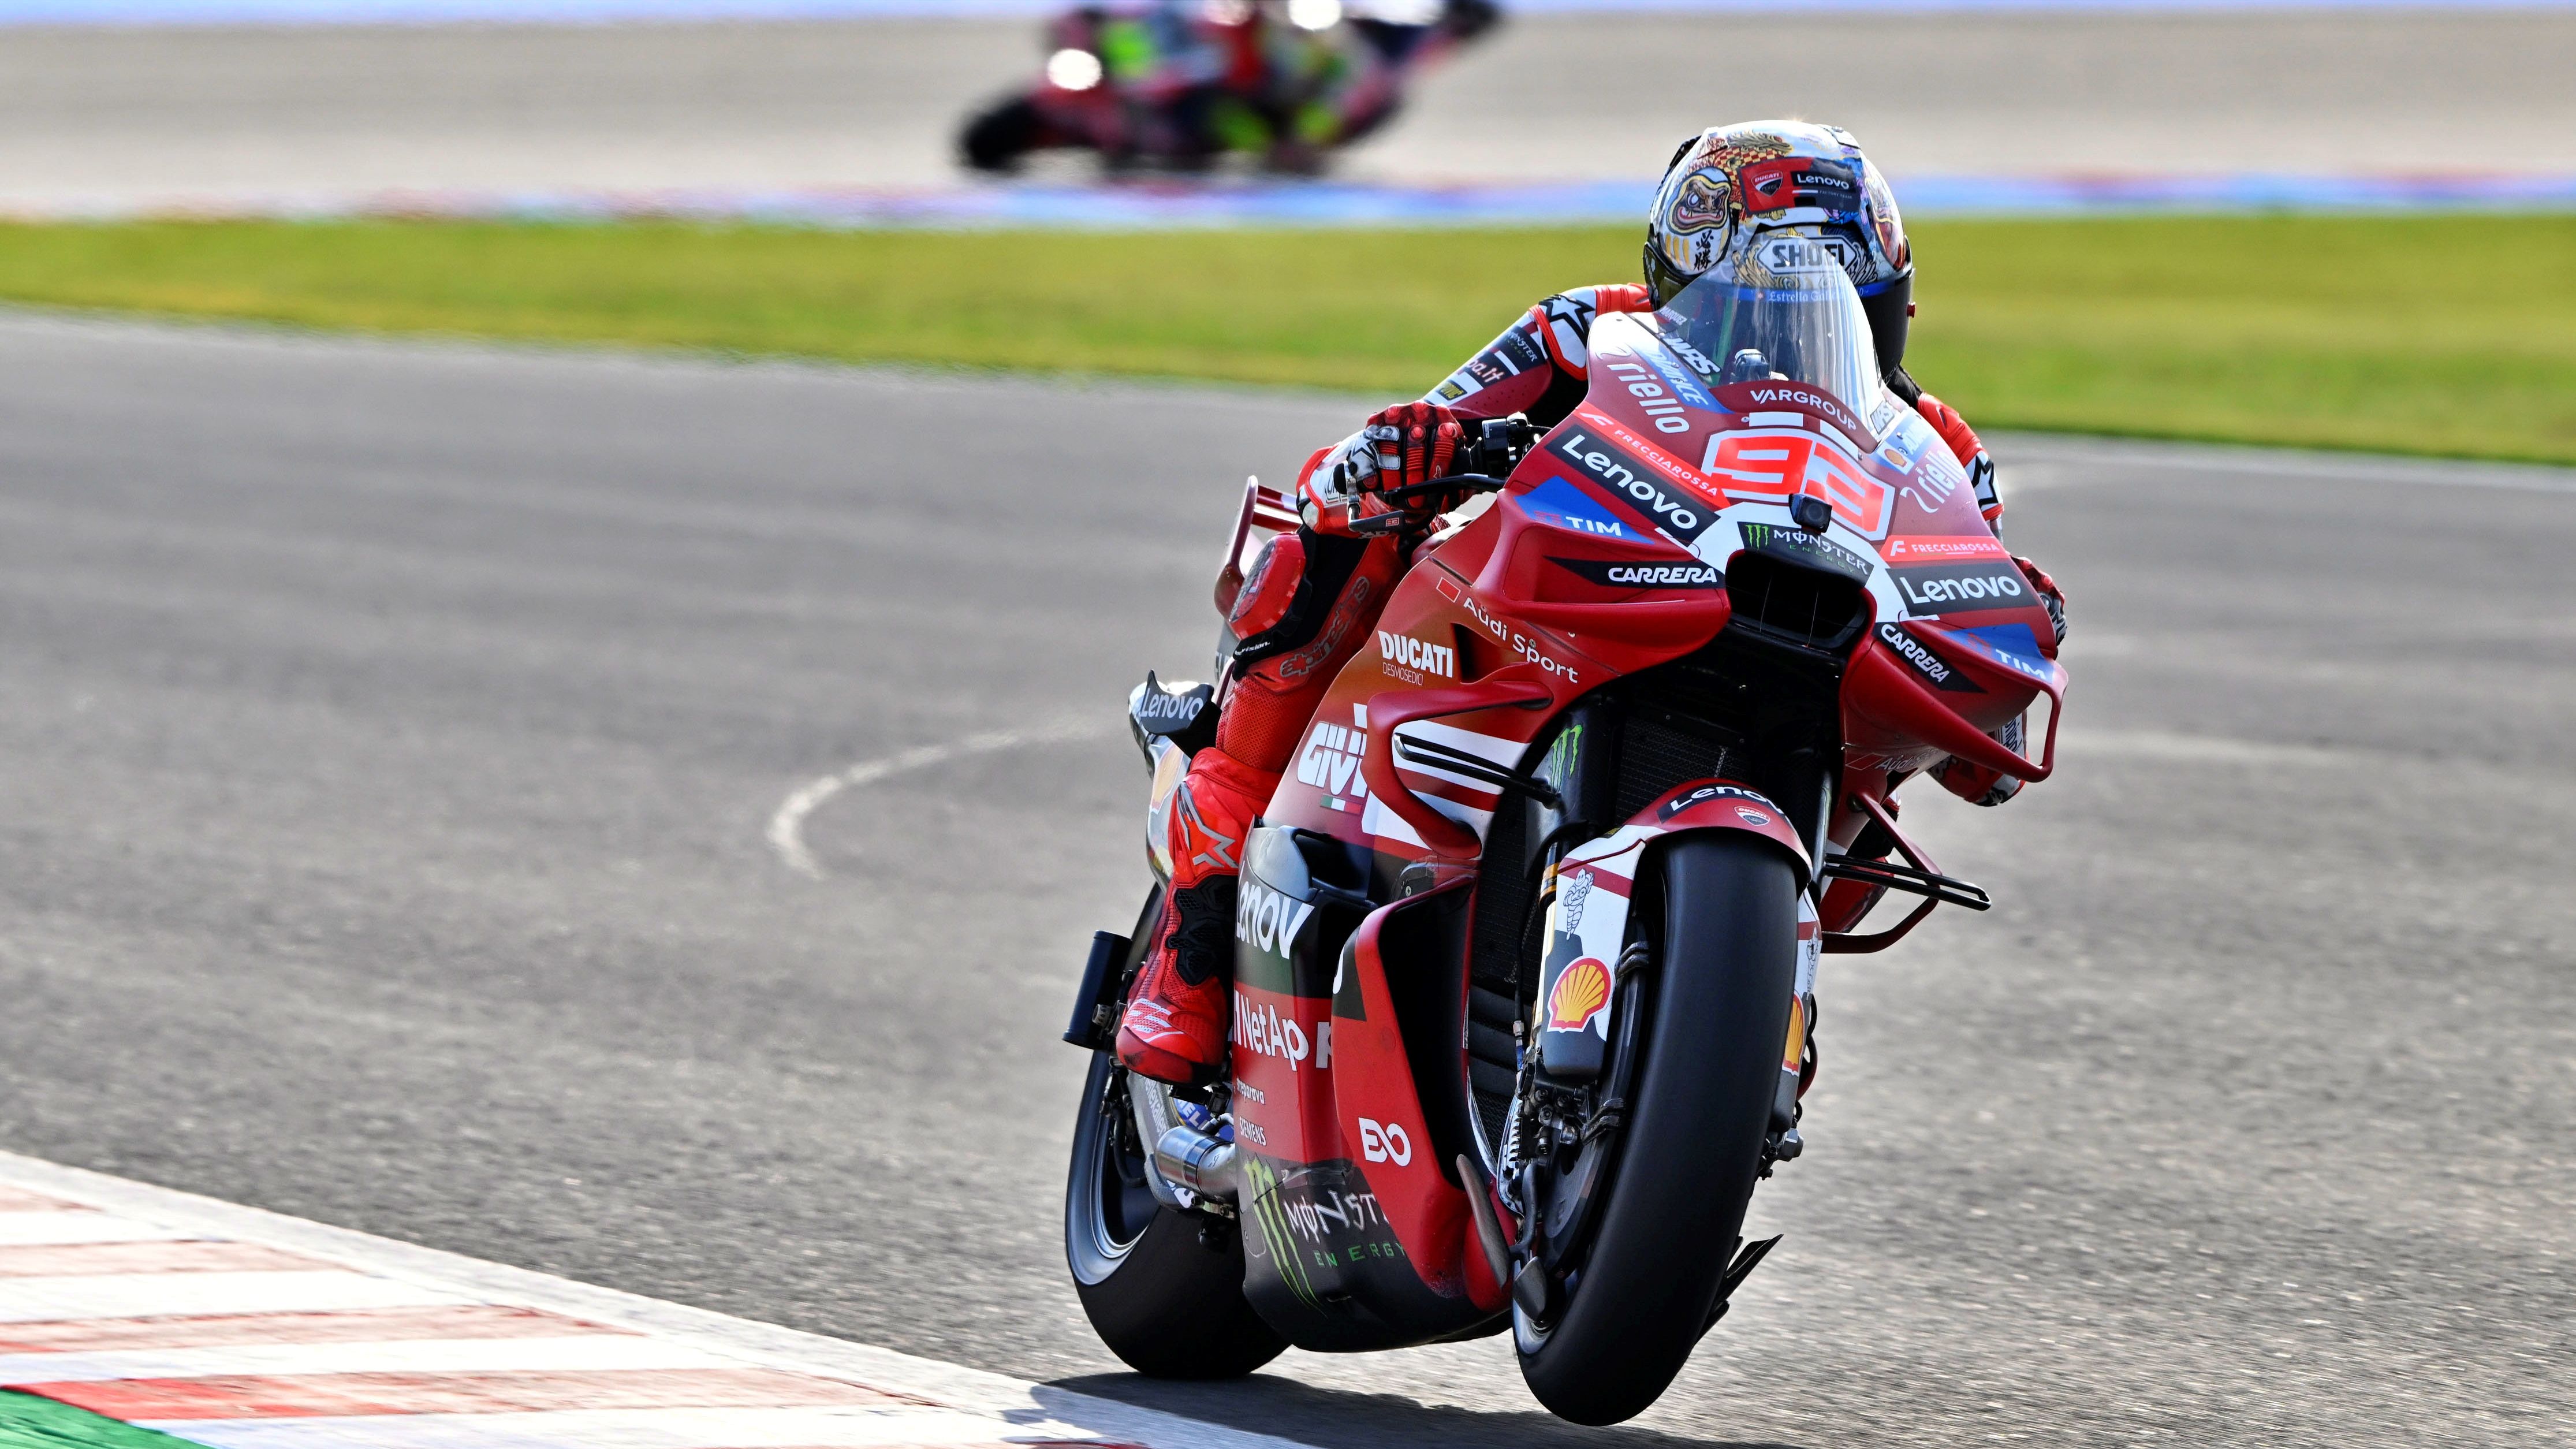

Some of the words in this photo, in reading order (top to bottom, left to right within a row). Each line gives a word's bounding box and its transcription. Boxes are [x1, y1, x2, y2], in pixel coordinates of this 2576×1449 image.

[1755, 173, 1779, 182] DUCATI
[1797, 174, 1850, 189] Lenovo
[1693, 230, 1714, 271] 必勝
[1662, 337, 1721, 374] WRS
[1607, 363, 1690, 433] riello
[1750, 389, 1856, 431] VARGROUP
[1614, 430, 1717, 497] FRECCIAROSSA
[1562, 434, 1698, 530] Lenovo
[1713, 435, 1885, 533] 93
[1565, 516, 1622, 537] TIM
[1773, 530, 1869, 575] MONSTER
[1789, 545, 1855, 574] ENERGY
[1911, 542, 2000, 553] FRECCIAROSSA
[1608, 567, 1717, 583] CARRERA
[1899, 576, 2022, 604] Lenovo
[1377, 630, 1453, 678] DUCATI
[1463, 597, 1507, 641] Audi
[1512, 633, 1579, 684] Sport
[1880, 624, 1950, 683] CARRERA
[1382, 662, 1423, 686] DESMOSEDICI
[1996, 649, 2048, 680] TIM
[1140, 688, 1203, 721] Lenovo
[1670, 786, 1784, 811] Lenov
[1738, 807, 1768, 819] DUCATI
[1236, 858, 1315, 960] Lenov
[1240, 1116, 1267, 1146] SIEMENS
[1283, 1189, 1389, 1243] MONST
